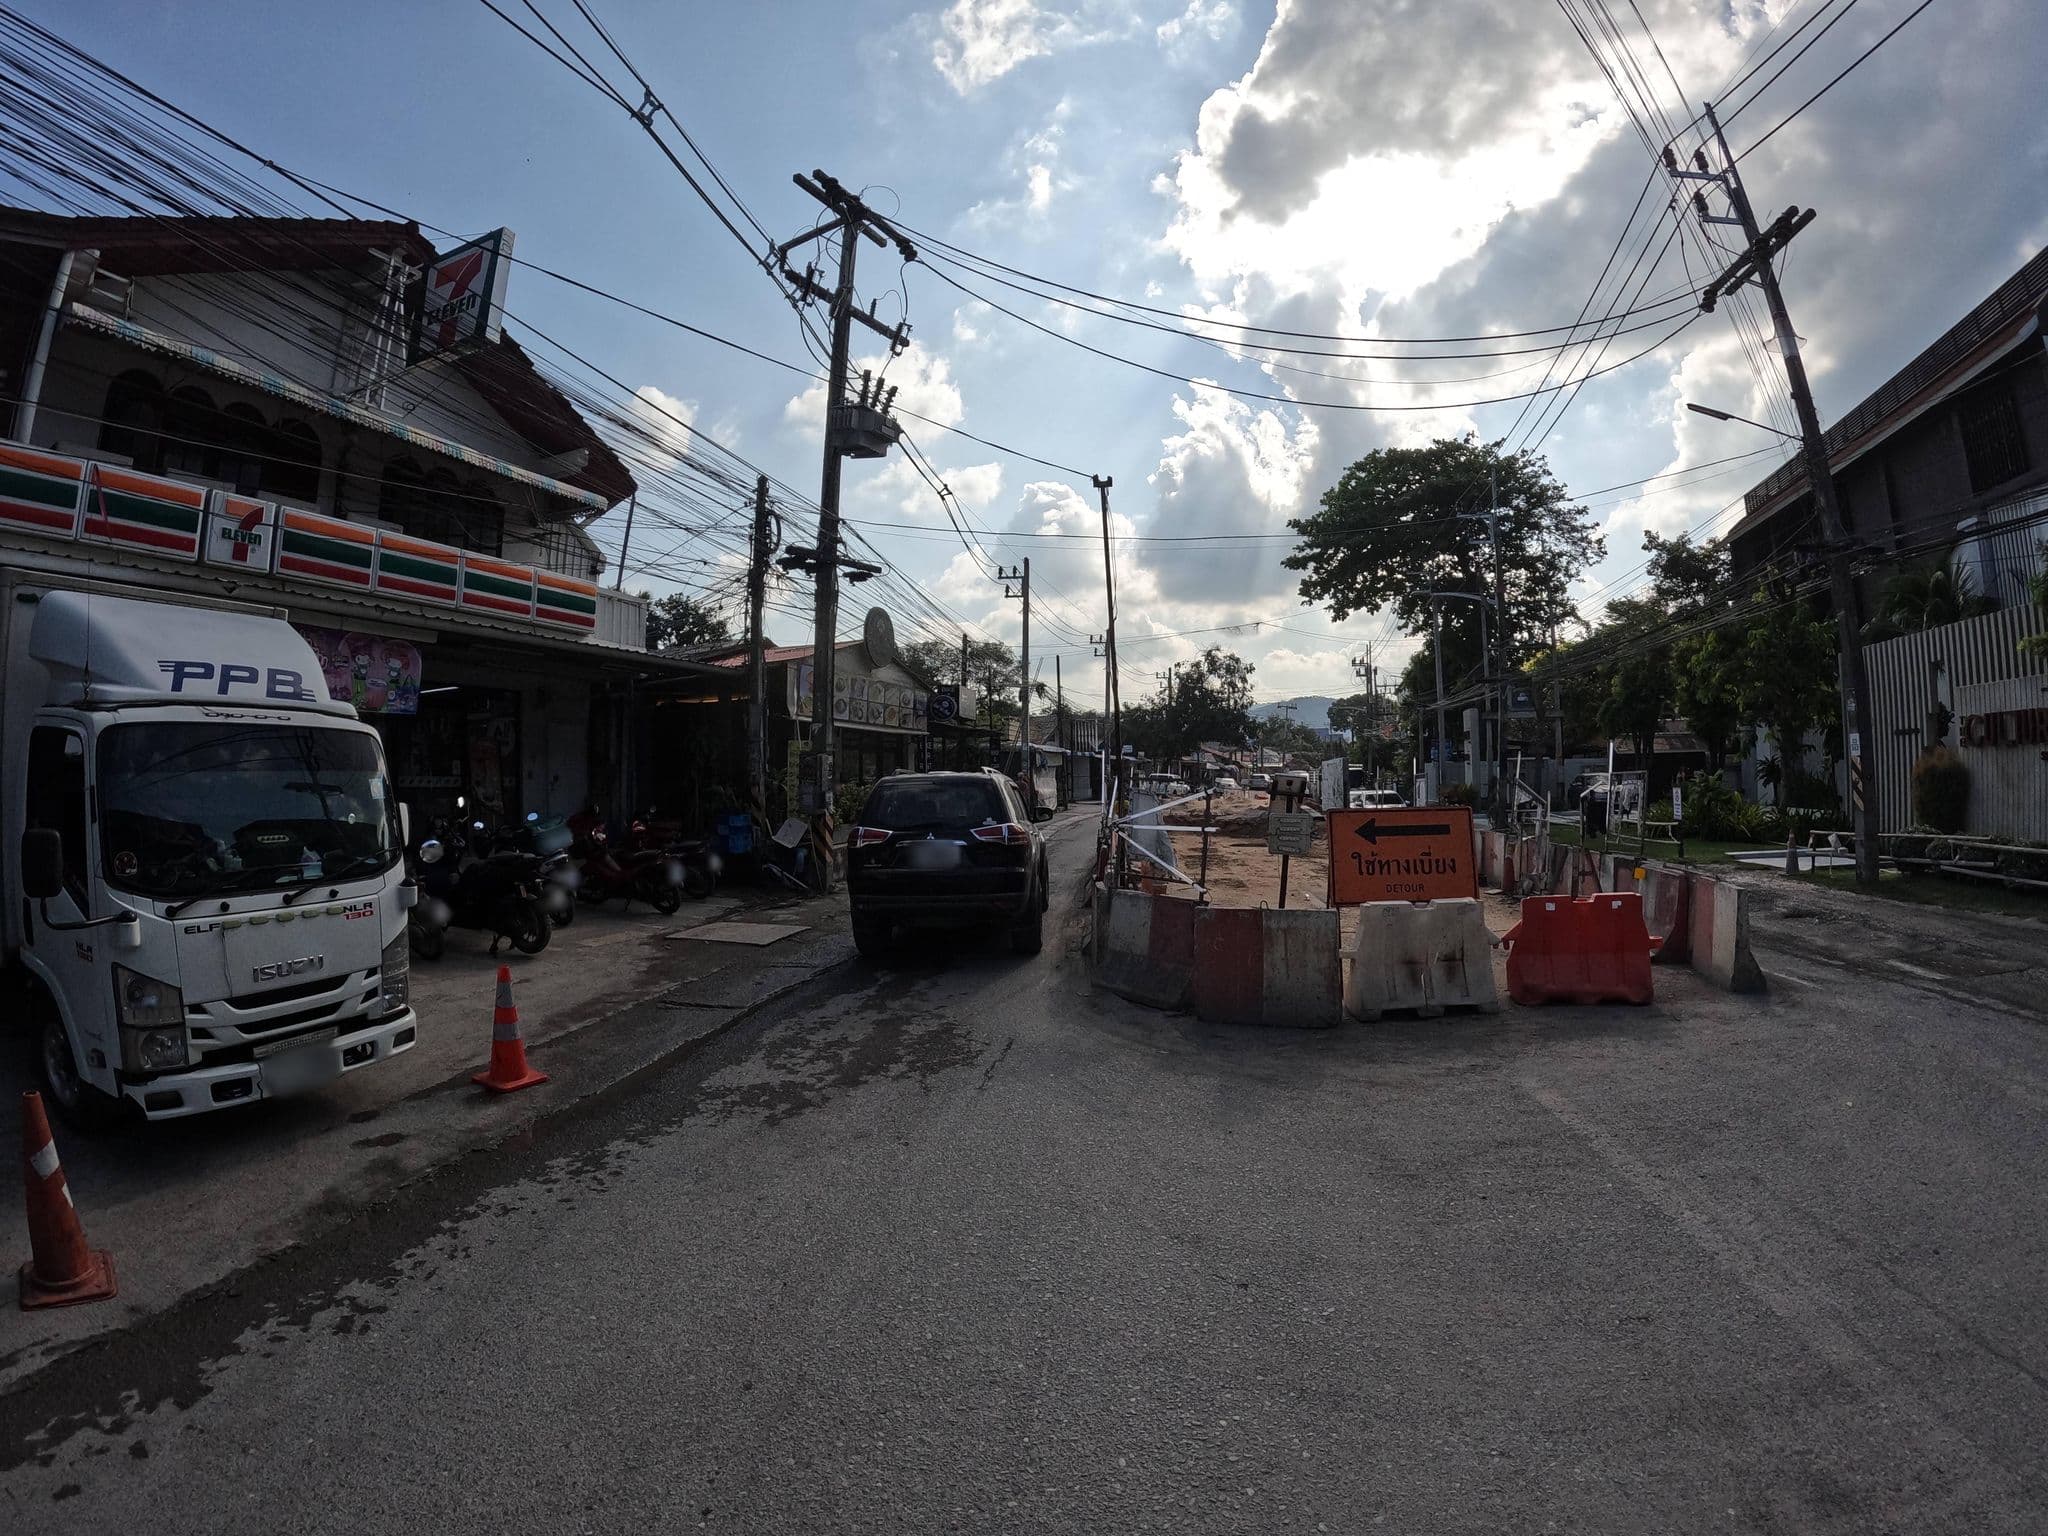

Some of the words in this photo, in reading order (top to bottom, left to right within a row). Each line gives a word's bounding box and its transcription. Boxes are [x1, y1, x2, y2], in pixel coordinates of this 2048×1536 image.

[158, 660, 316, 702] PPB
[1351, 846, 1457, 876] ใช้ทางเบี่ยง
[1386, 883, 1425, 893] DETOUR
[343, 902, 373, 914] NLR
[343, 910, 374, 921] 130
[184, 922, 221, 935] ELF
[252, 954, 324, 984] ISUZU
